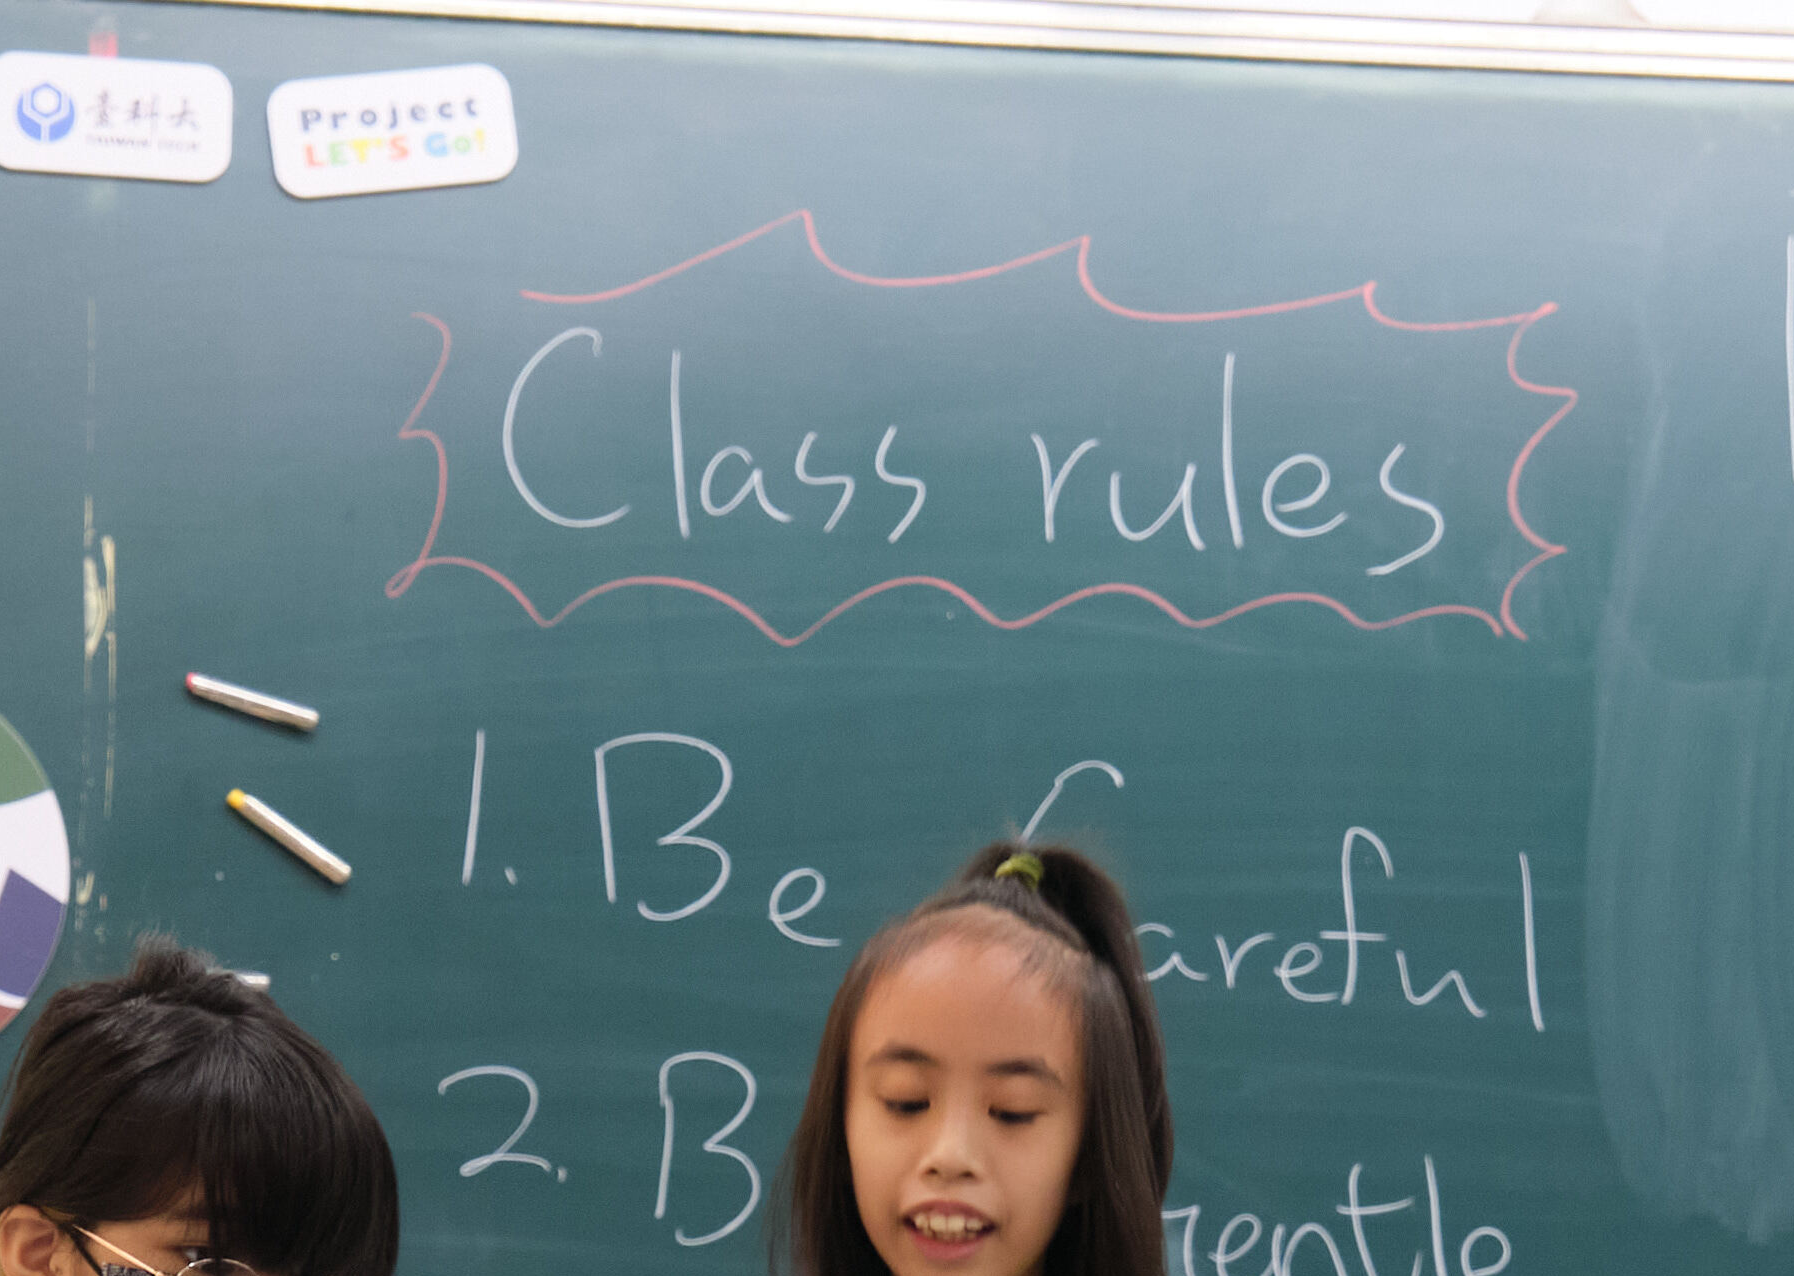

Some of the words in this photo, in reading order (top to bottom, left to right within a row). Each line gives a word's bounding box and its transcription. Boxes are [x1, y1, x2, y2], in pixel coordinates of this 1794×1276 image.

[300, 97, 479, 133] Project
[304, 137, 409, 168] LET'S
[503, 326, 929, 545] Class
[1032, 352, 1446, 577] rules
[460, 730, 519, 888] 1.
[595, 733, 844, 950] Be
[438, 1065, 568, 1183] 2.
